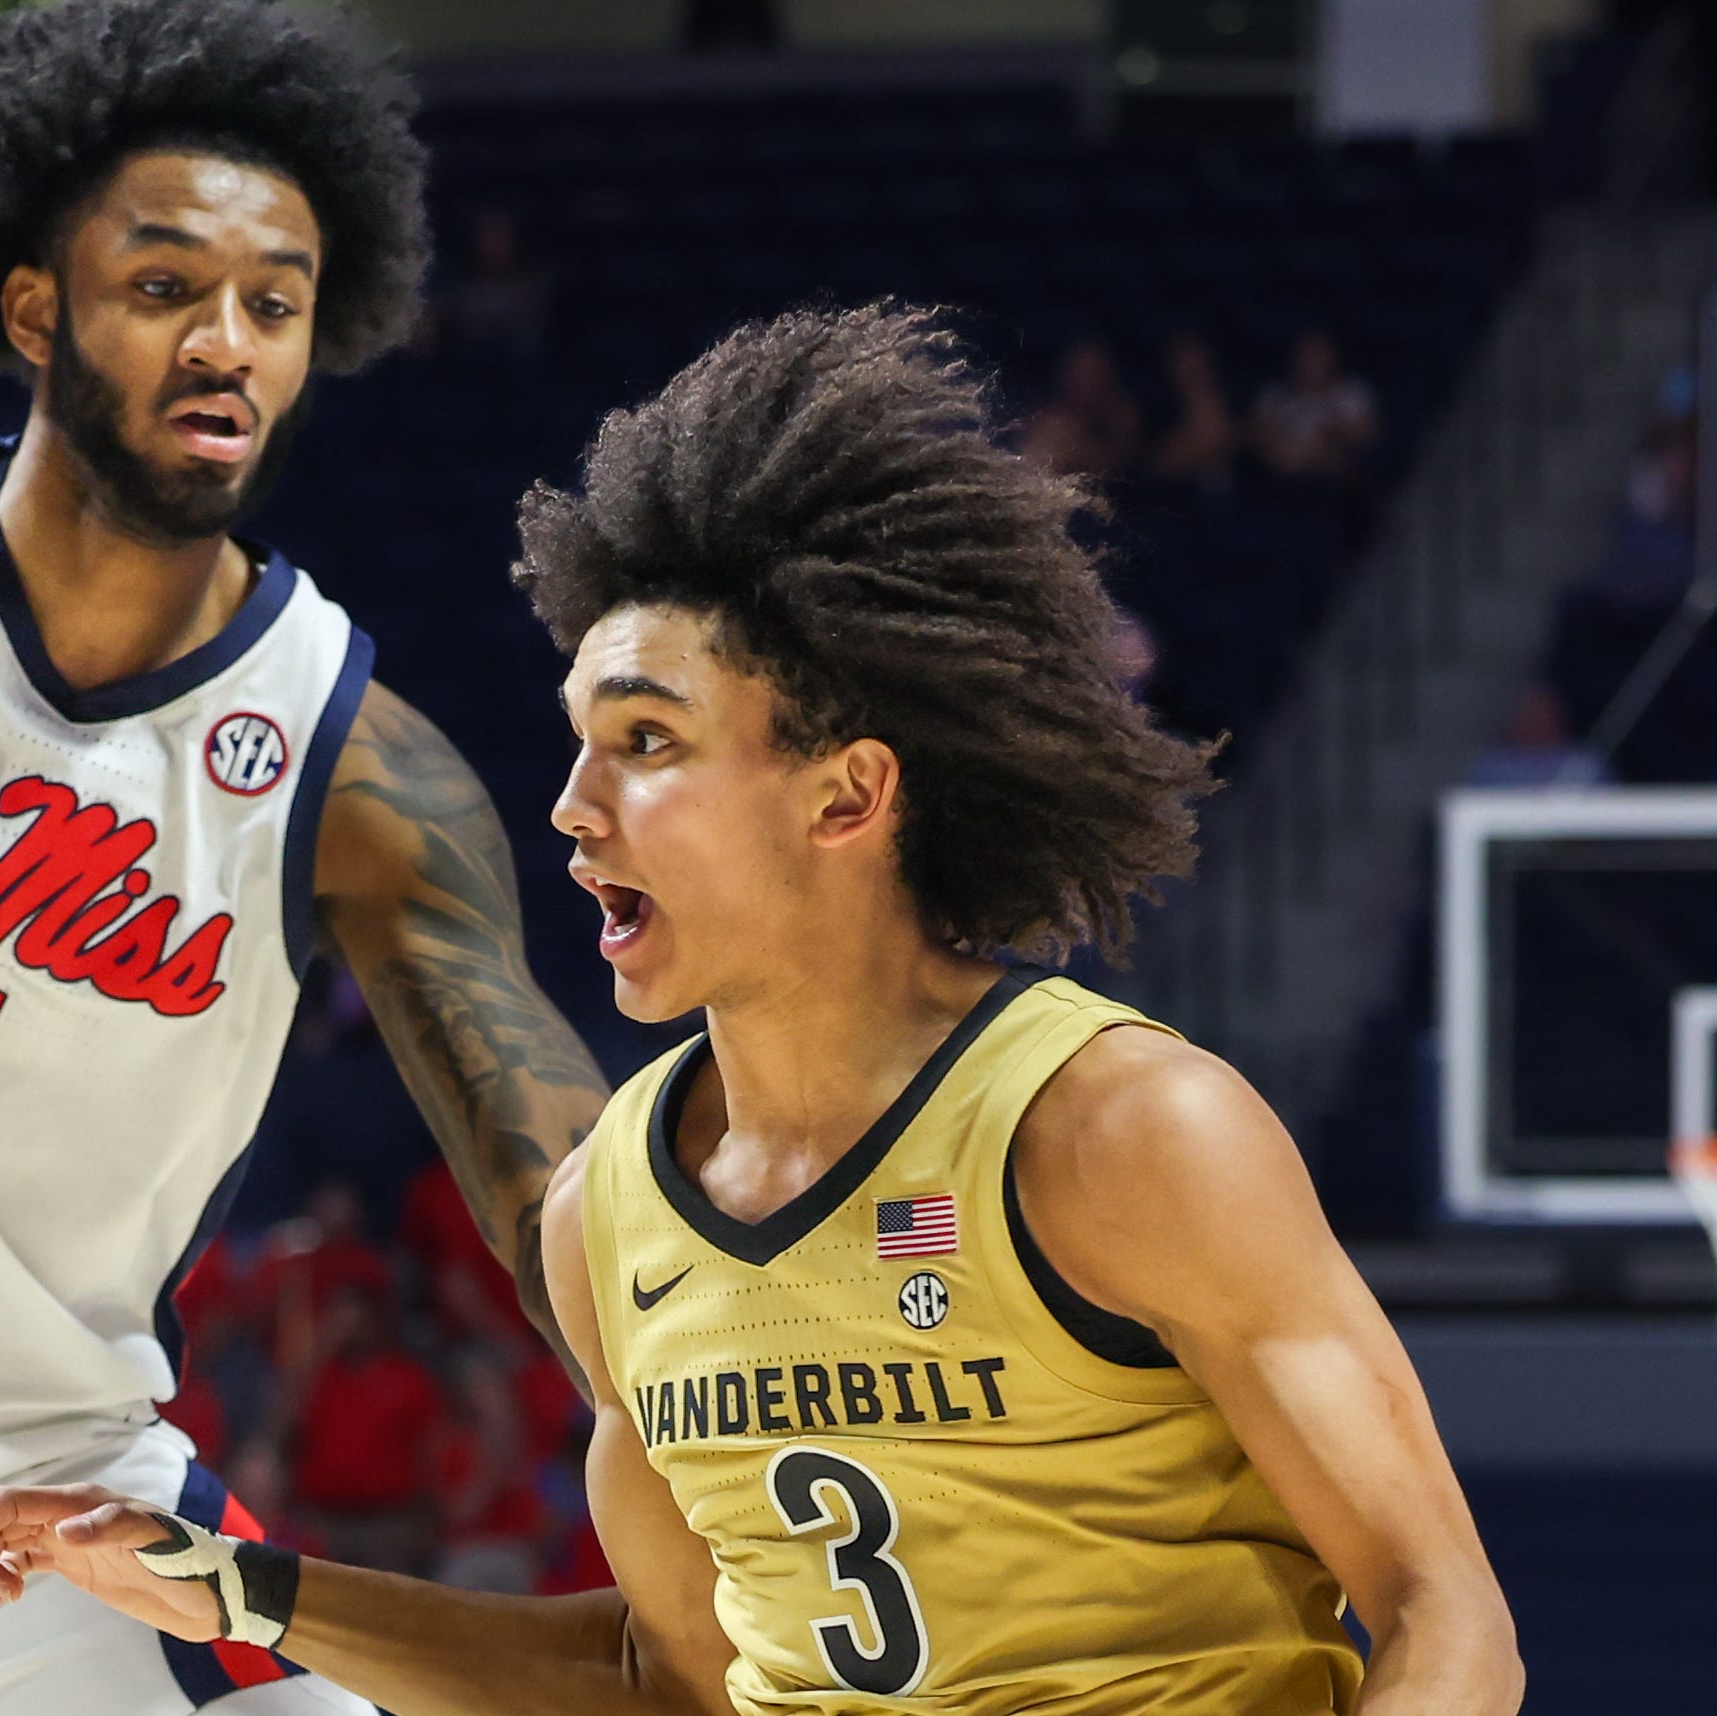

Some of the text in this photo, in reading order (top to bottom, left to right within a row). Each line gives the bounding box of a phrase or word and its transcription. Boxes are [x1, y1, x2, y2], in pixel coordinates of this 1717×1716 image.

[209, 715, 285, 791] SEC
[900, 1274, 948, 1327] SEC
[635, 1356, 1006, 1449] VANDERBILT
[764, 1444, 930, 1698] 3
